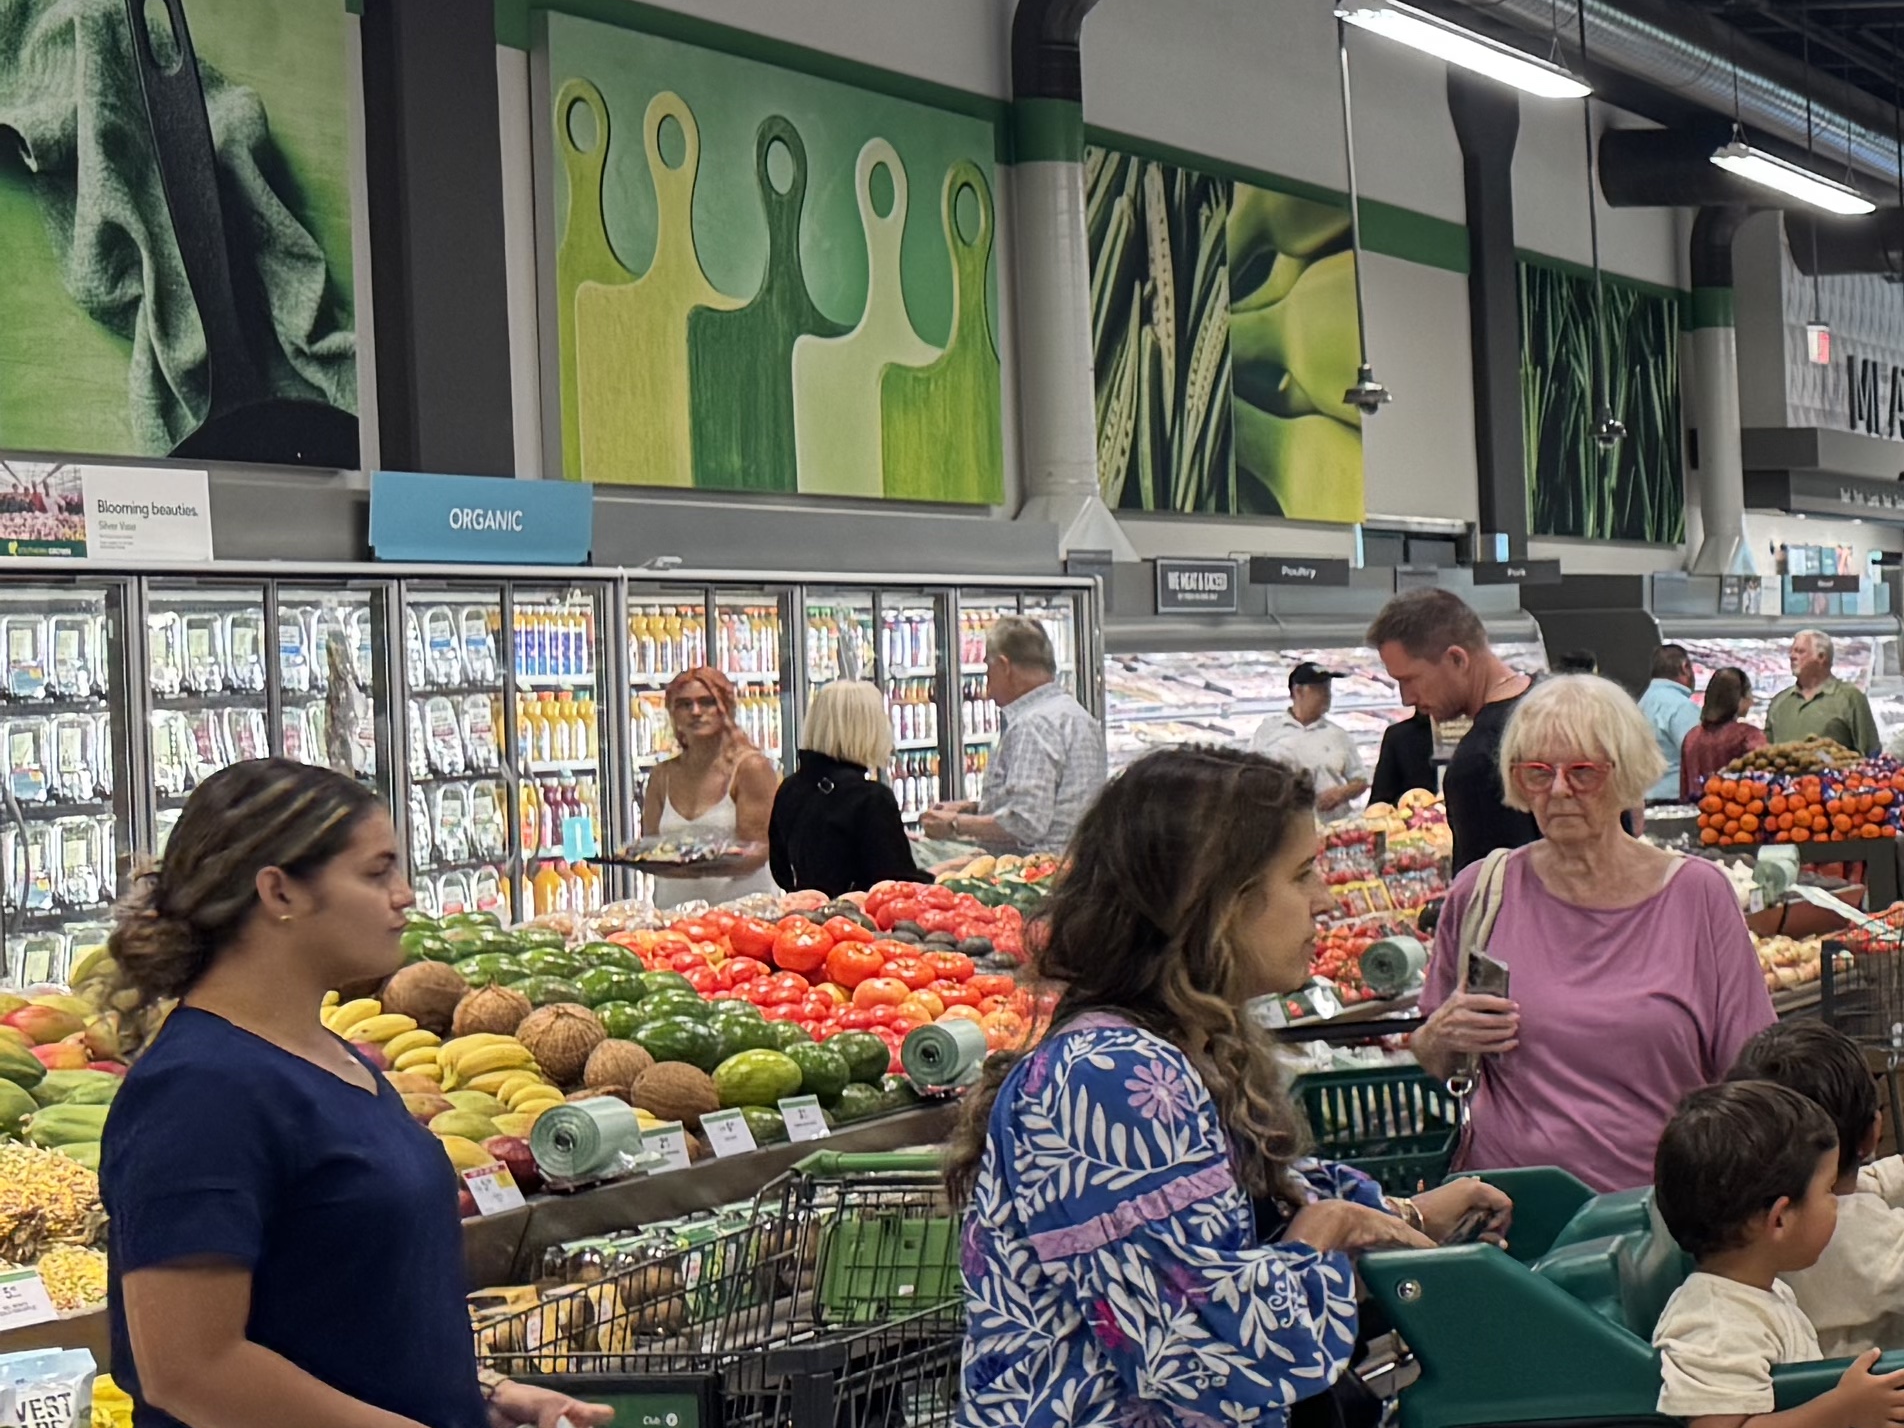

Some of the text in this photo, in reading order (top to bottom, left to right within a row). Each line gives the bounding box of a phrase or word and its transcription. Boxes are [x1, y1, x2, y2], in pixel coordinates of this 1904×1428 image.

[97, 499, 199, 519] Blooming beauties.
[448, 508, 524, 533] ORGANIC
[643, 1415, 661, 1426] Club
